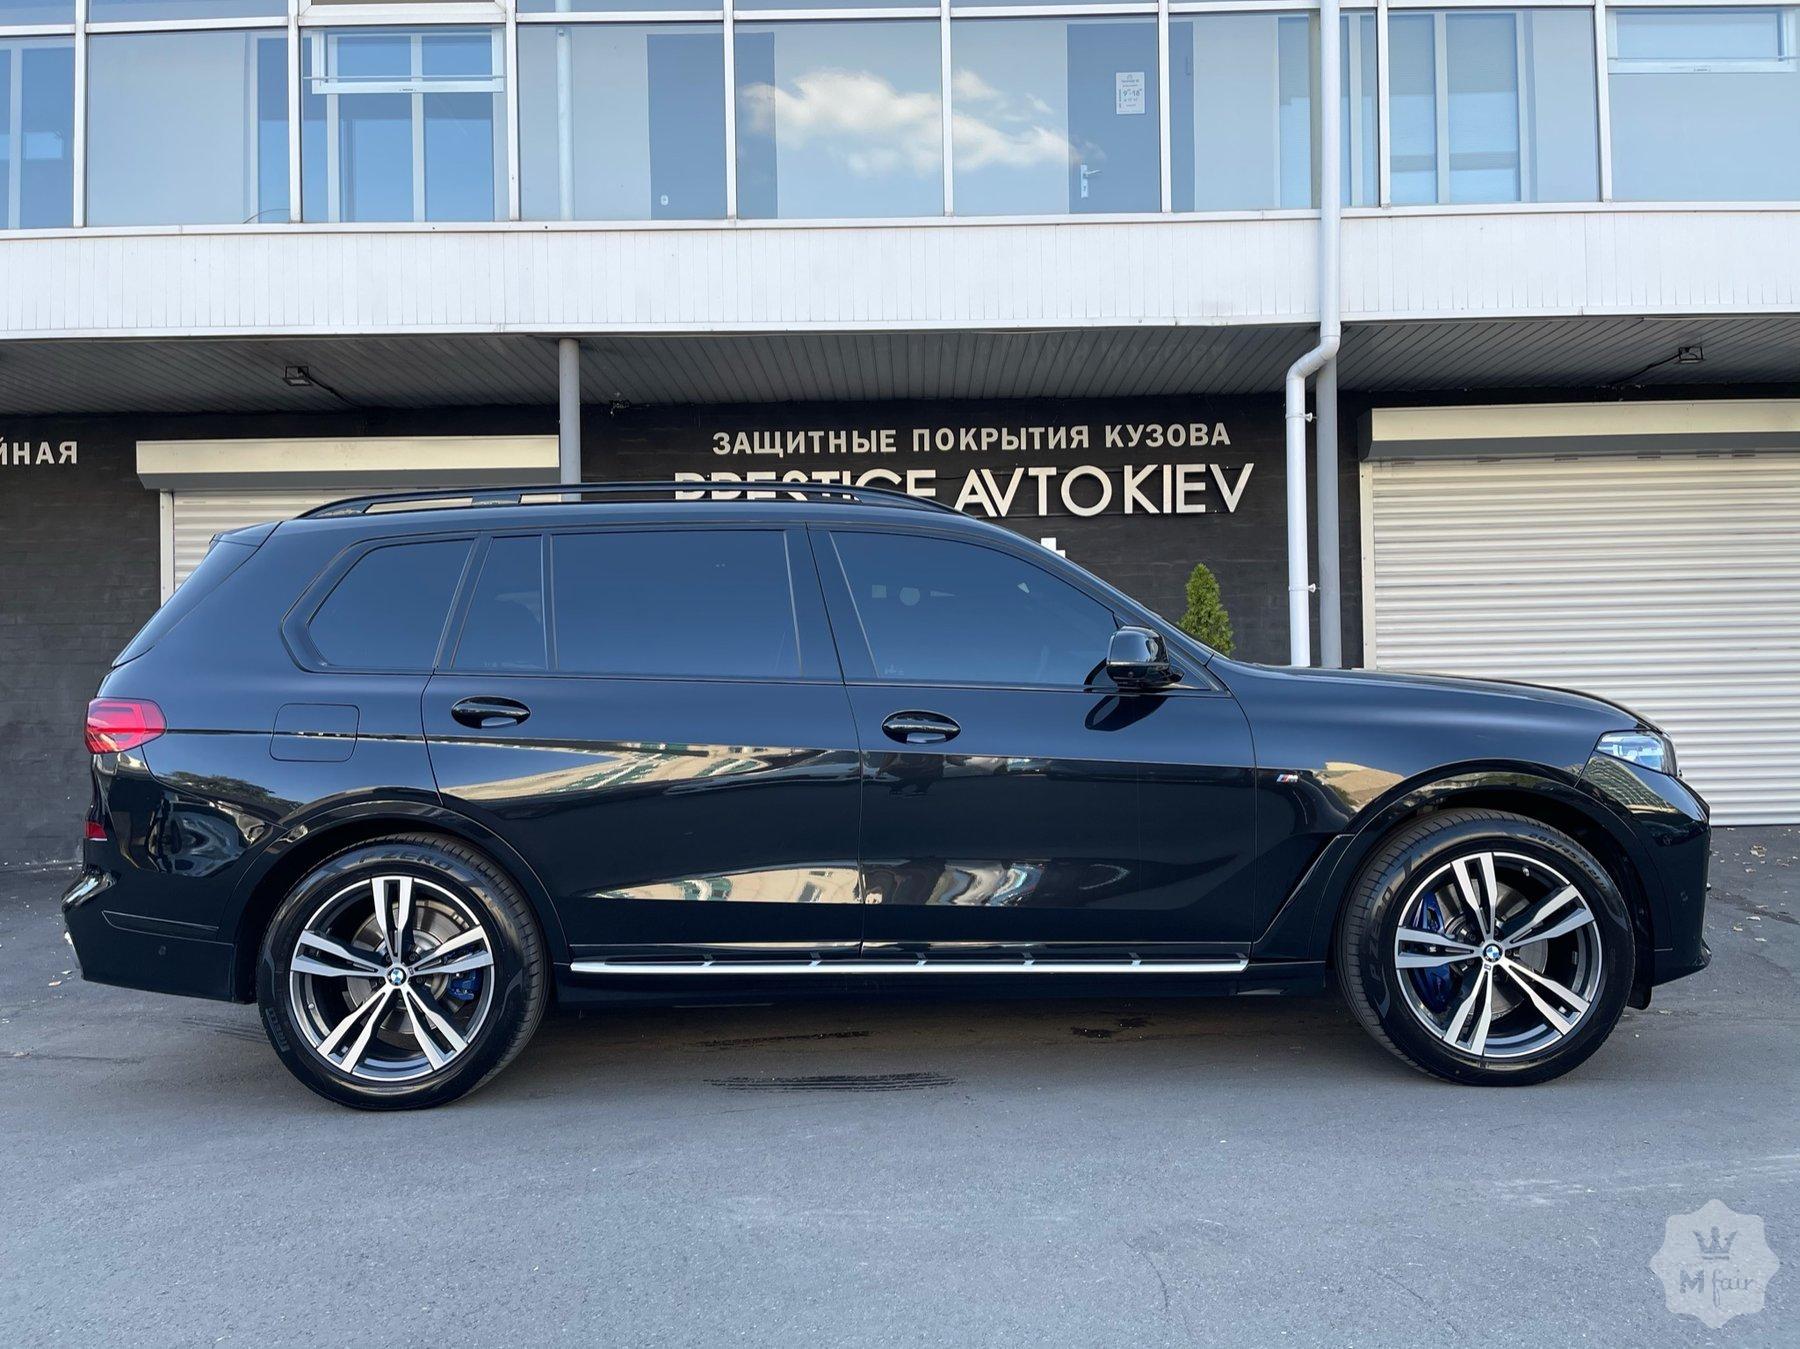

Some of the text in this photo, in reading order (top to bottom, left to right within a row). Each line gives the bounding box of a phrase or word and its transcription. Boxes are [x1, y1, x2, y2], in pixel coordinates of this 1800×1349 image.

[713, 422, 1231, 458] ЗАЩИТНЫЕ ПОКРЫТИЯ КУЗОВА
